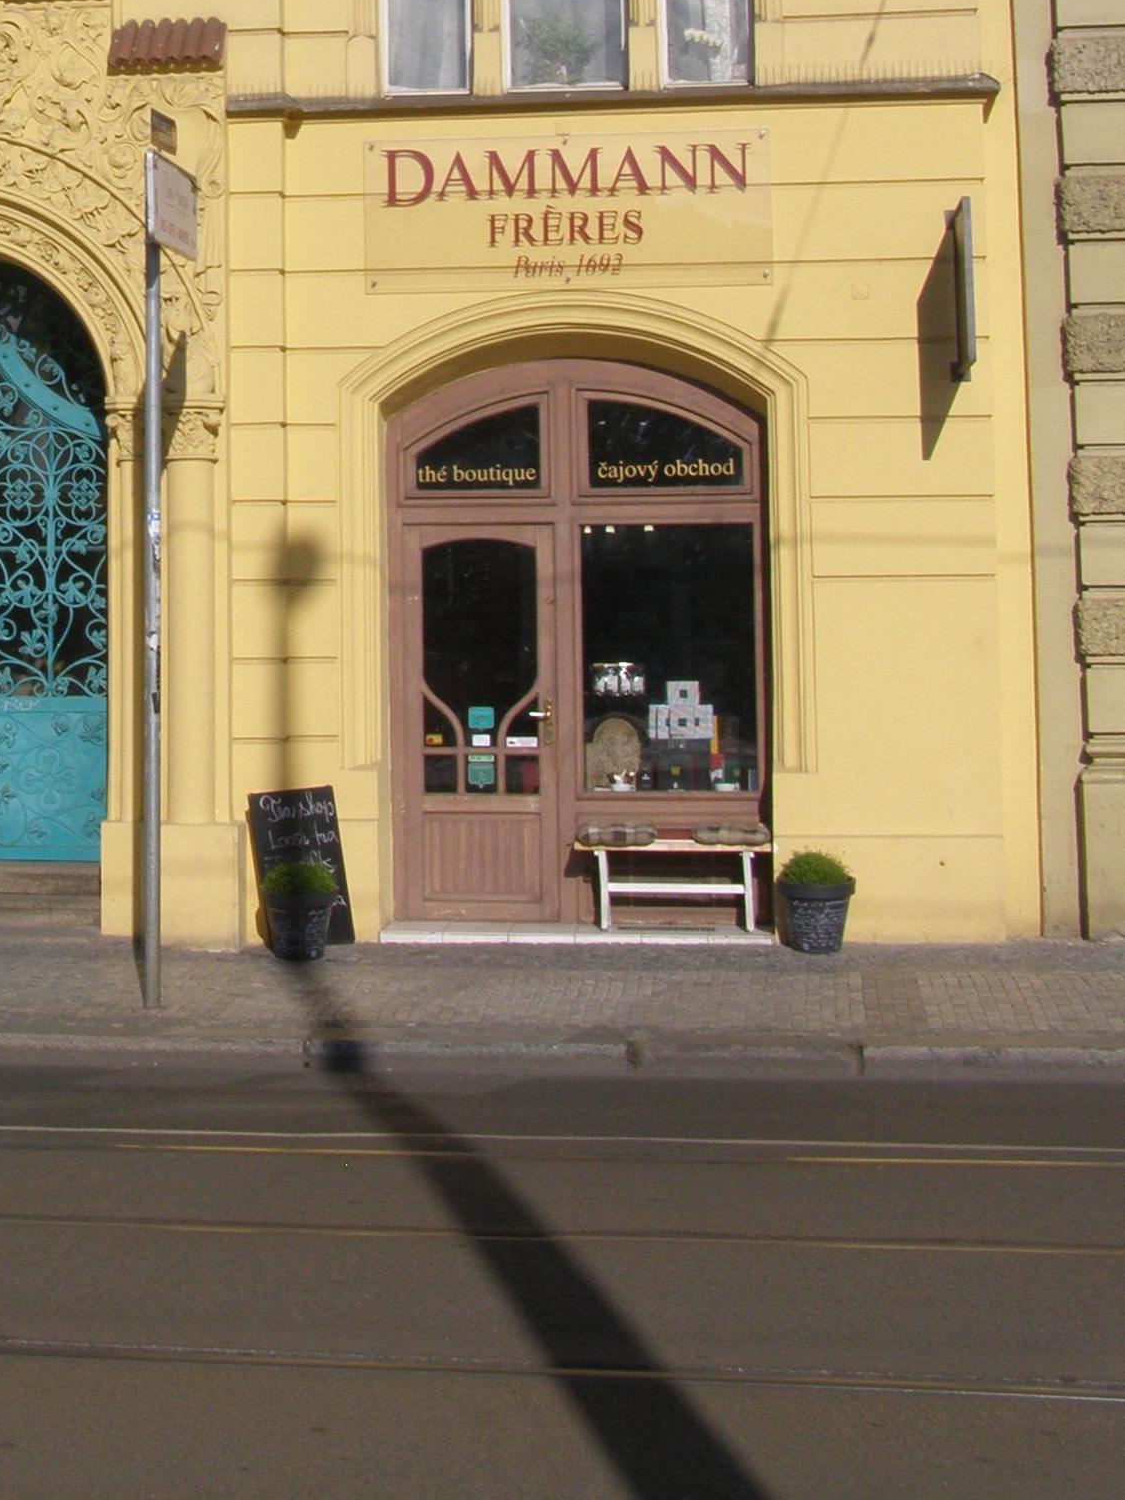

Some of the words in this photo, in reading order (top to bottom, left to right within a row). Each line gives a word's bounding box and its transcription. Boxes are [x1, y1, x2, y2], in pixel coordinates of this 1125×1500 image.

[381, 142, 750, 207] DAMMANN
[487, 205, 644, 248] FRÈRES
[513, 253, 565, 279] Paris
[417, 464, 447, 482] thé
[453, 463, 536, 486] boutique
[597, 460, 659, 483] čajový
[663, 457, 735, 477] obchod
[299, 791, 335, 823] shop
